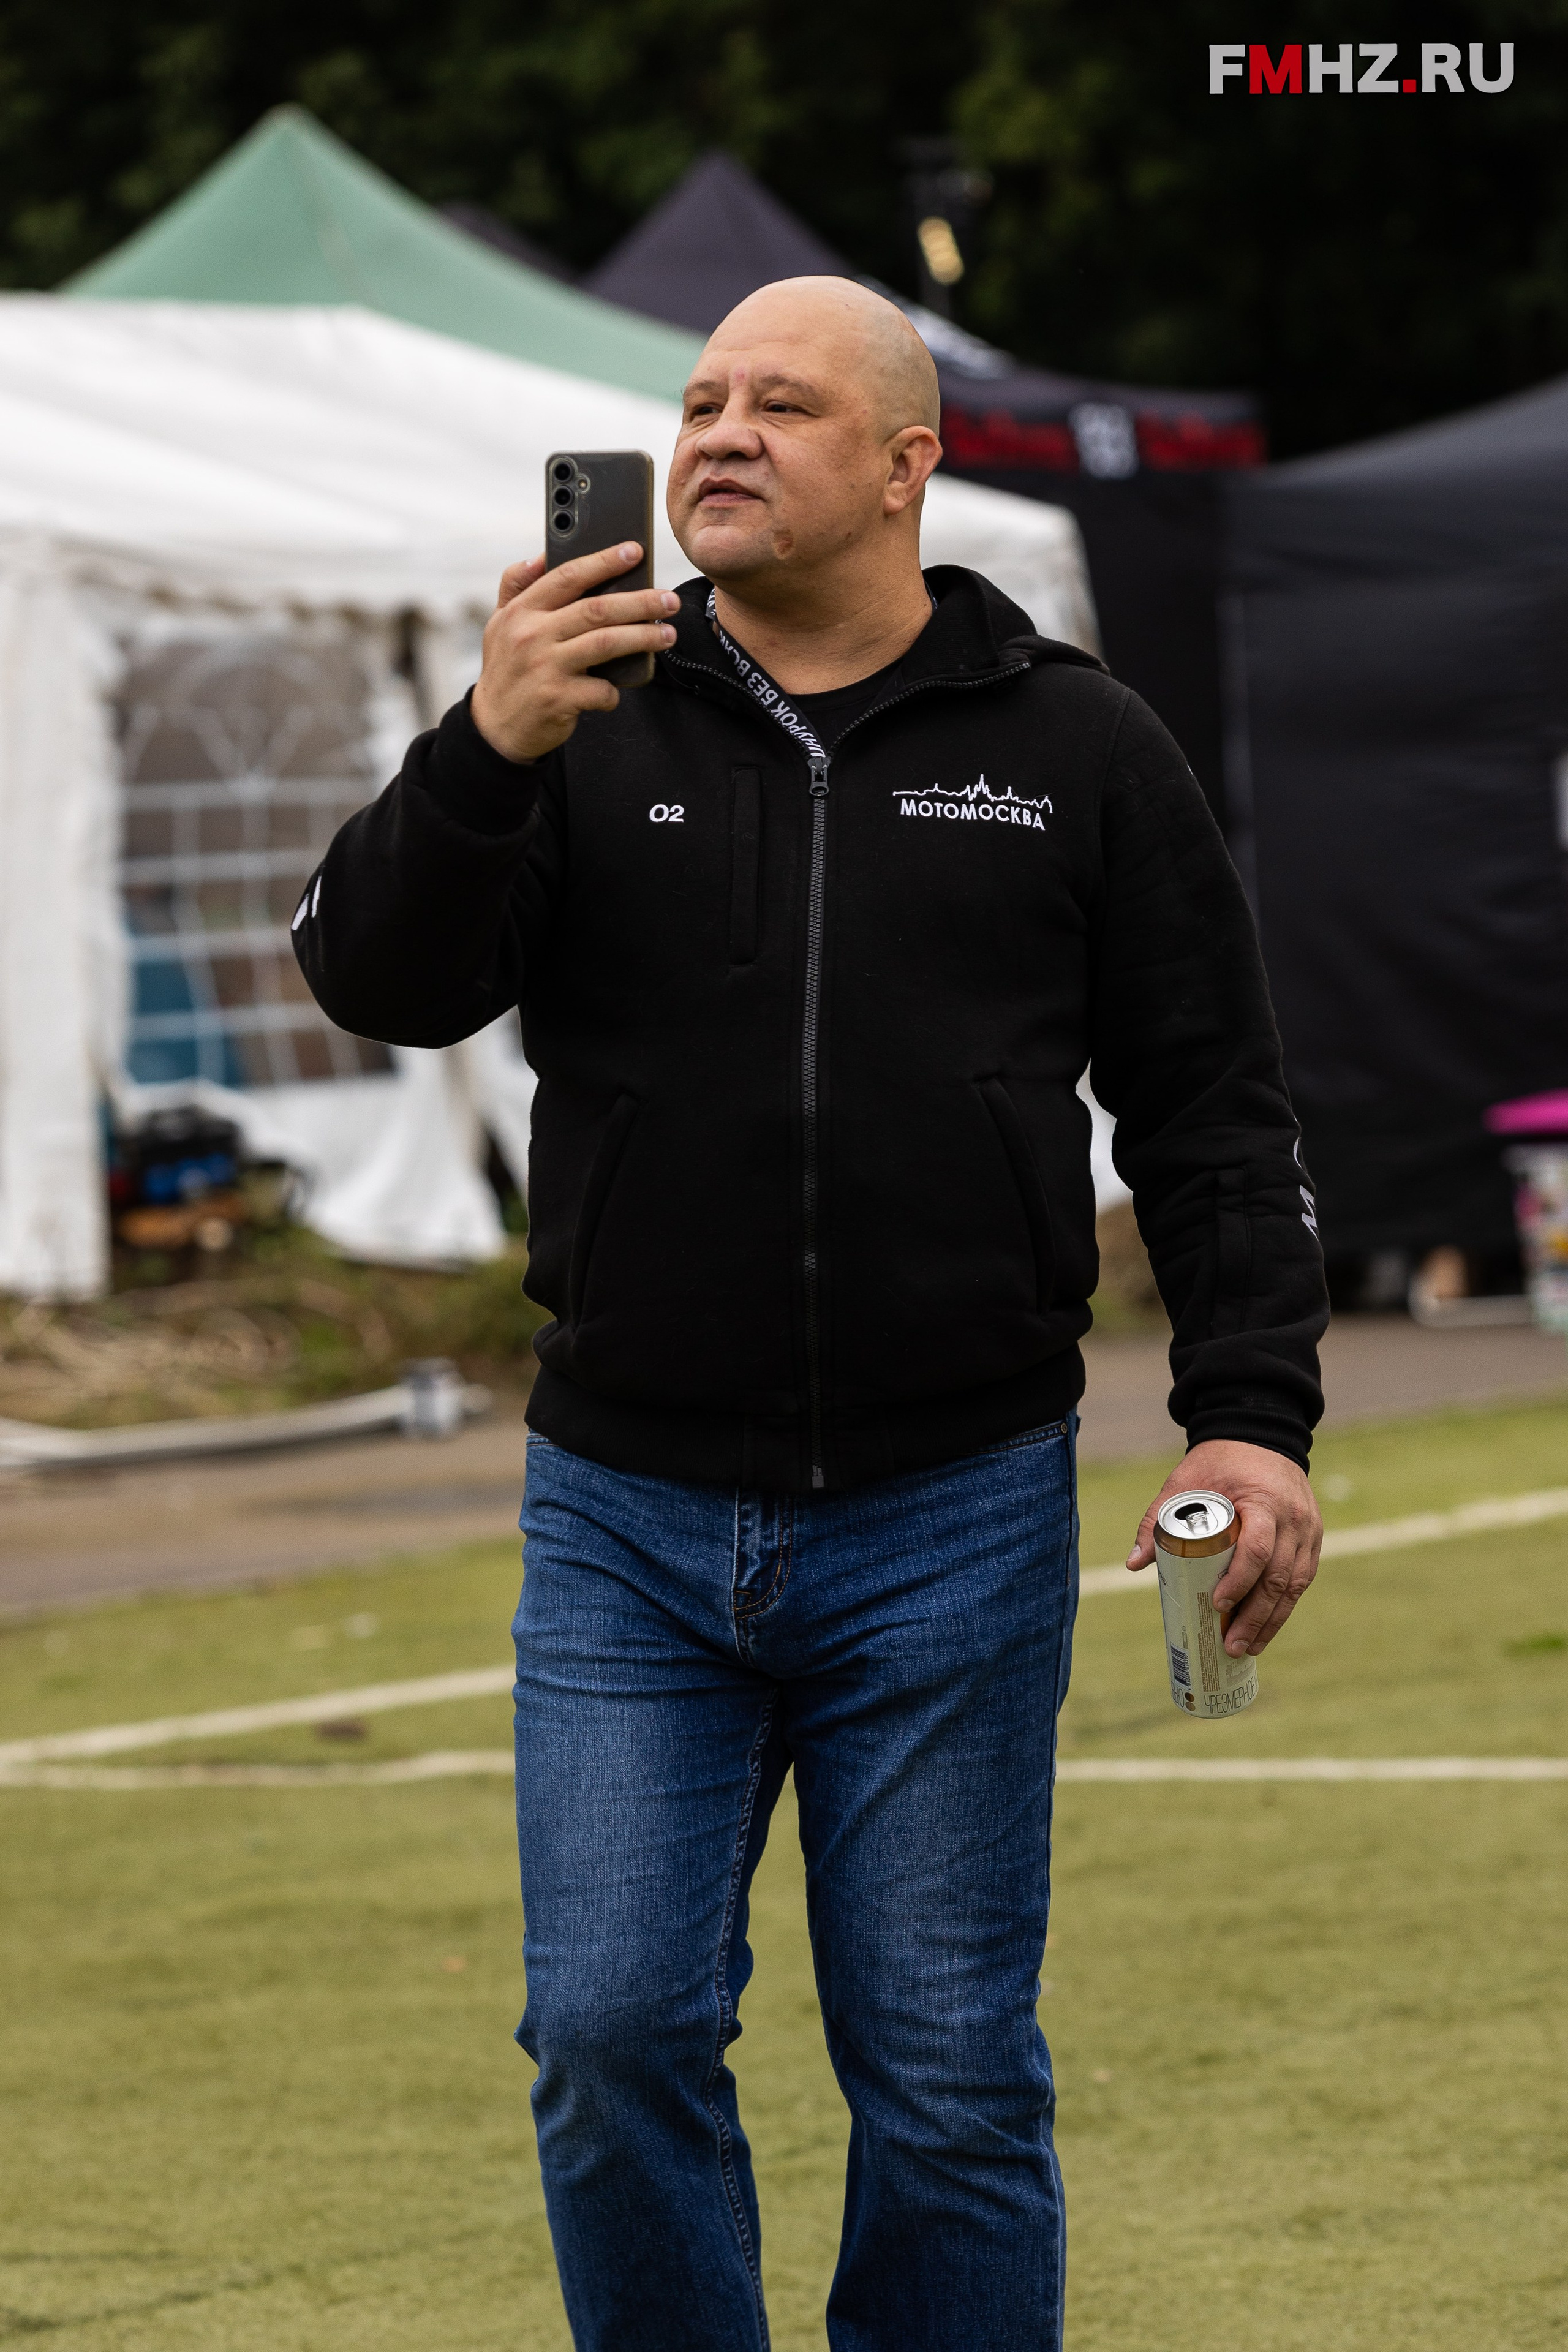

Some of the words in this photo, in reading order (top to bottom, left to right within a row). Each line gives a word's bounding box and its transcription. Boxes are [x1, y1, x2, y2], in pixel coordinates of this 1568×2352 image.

[747, 672, 779, 706] БЕЗ
[900, 798, 1046, 831] МОТОМОСКВА
[1204, 1676, 1256, 1714] ЧРЕЗМЕРНОЕ
